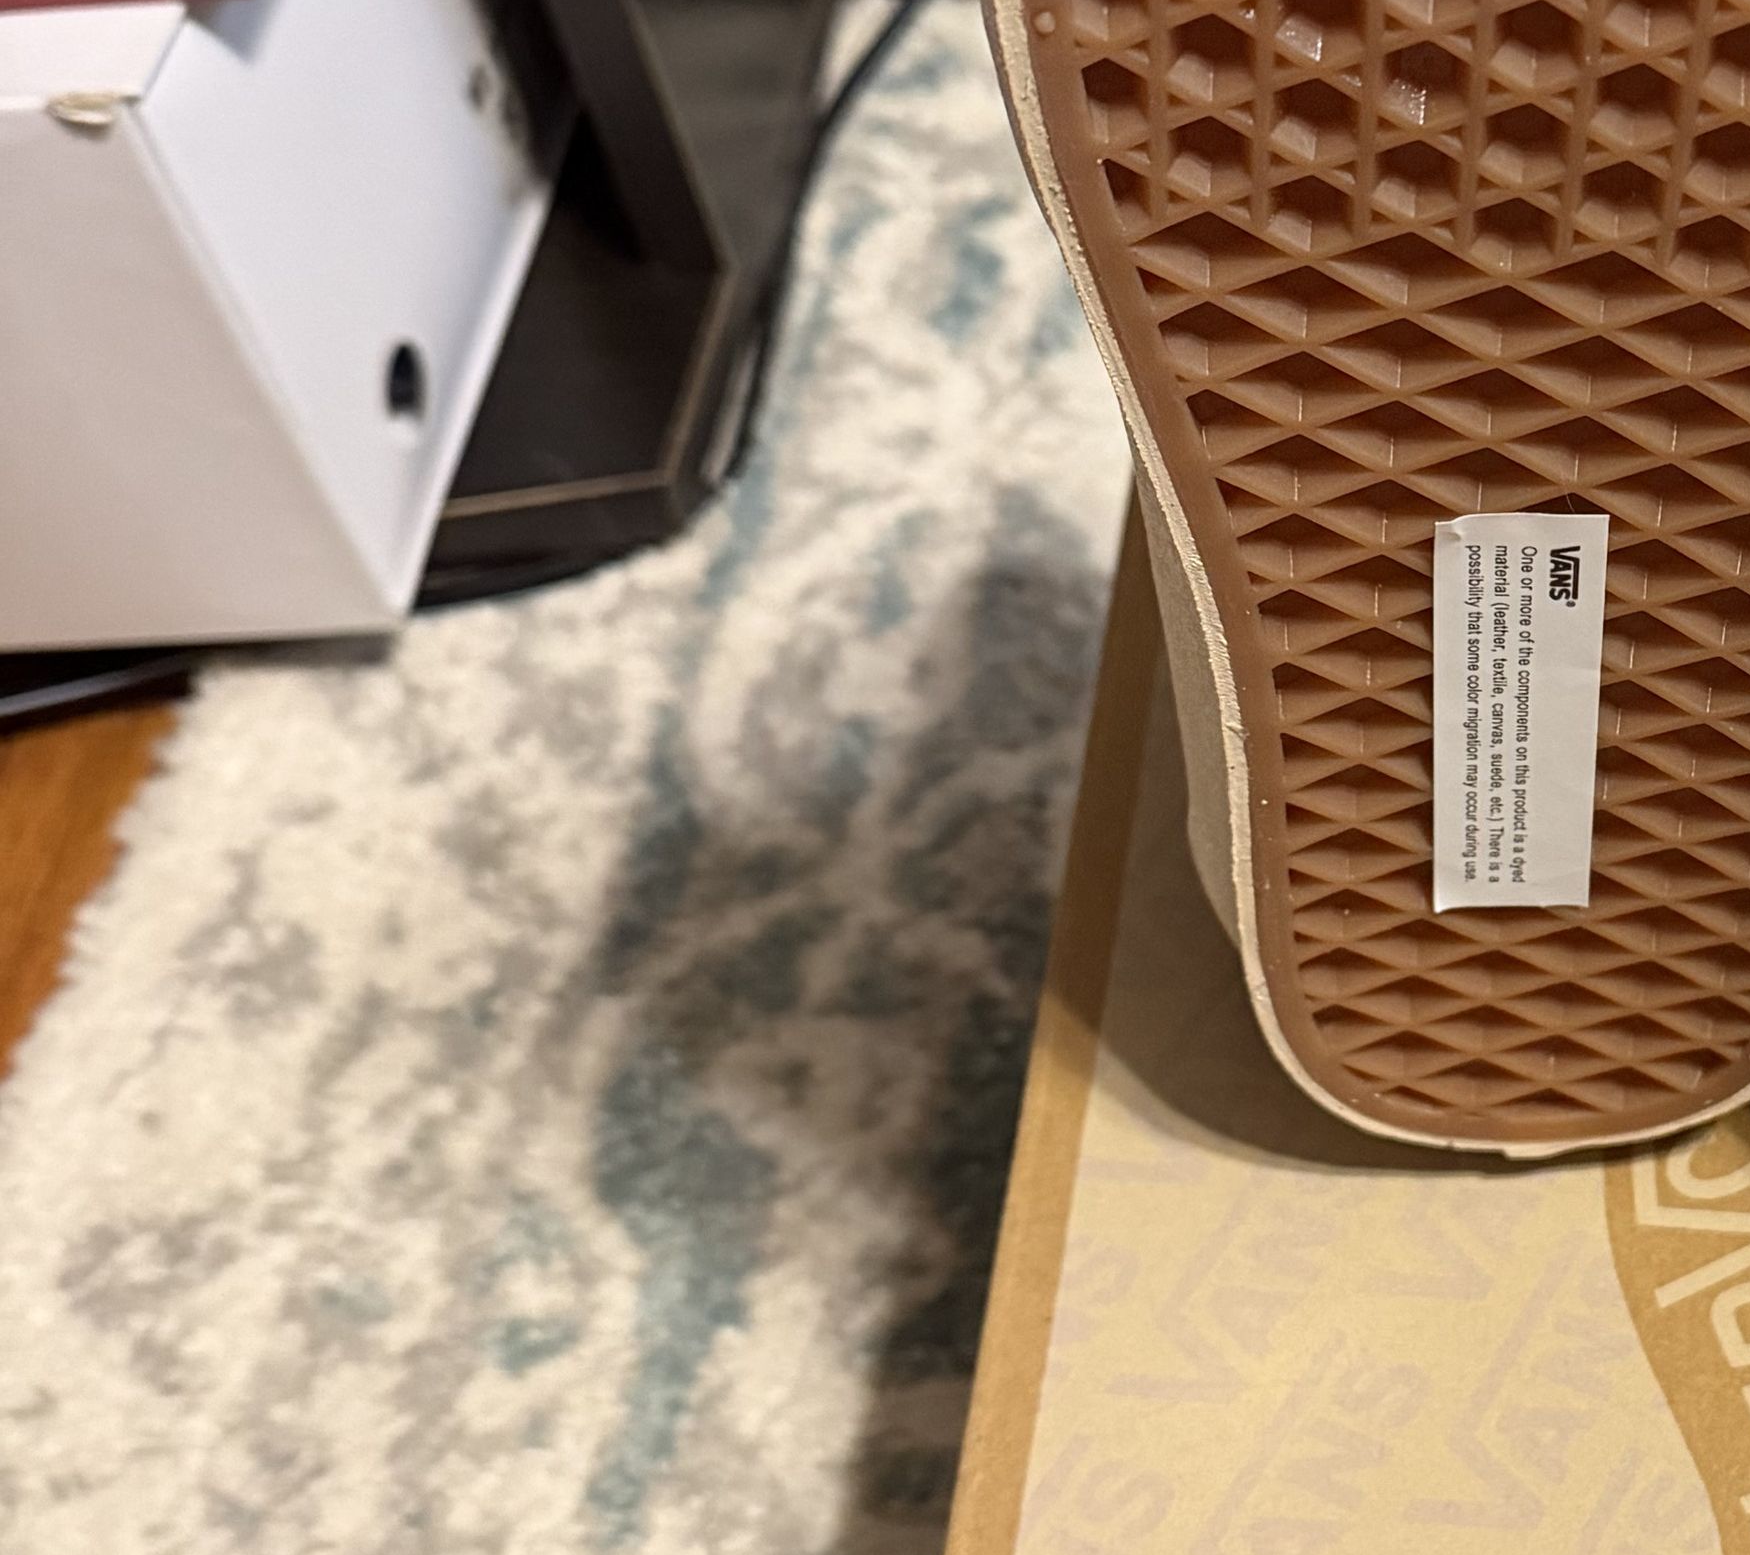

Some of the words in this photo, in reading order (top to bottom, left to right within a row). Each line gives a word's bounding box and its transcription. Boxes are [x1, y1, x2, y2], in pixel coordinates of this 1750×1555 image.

[1494, 545, 1510, 597] material
[1520, 546, 1538, 573] One
[1463, 545, 1485, 608] possibility
[1520, 577, 1533, 591] or
[1467, 611, 1484, 635] that
[1519, 595, 1533, 626] more
[1490, 602, 1510, 653] (leather,
[1518, 631, 1535, 644] of
[1467, 638, 1480, 671] some
[1518, 647, 1534, 666] the
[1467, 674, 1482, 704] color
[1490, 658, 1508, 698] textile,
[1513, 670, 1531, 743] components
[1462, 707, 1483, 761] migration
[1489, 703, 1505, 749] canvas,
[1515, 747, 1528, 761] on
[1462, 764, 1479, 789] may
[1488, 753, 1505, 792] suede,
[1514, 764, 1531, 786] this
[1465, 791, 1478, 822] occur
[1485, 796, 1504, 822] etc.)
[1511, 789, 1529, 831] product
[1461, 824, 1480, 858] during
[1488, 826, 1505, 858] There
[1512, 834, 1528, 843] is
[1488, 862, 1503, 871] is
[1488, 875, 1500, 883] a
[1509, 857, 1527, 883] dyed
